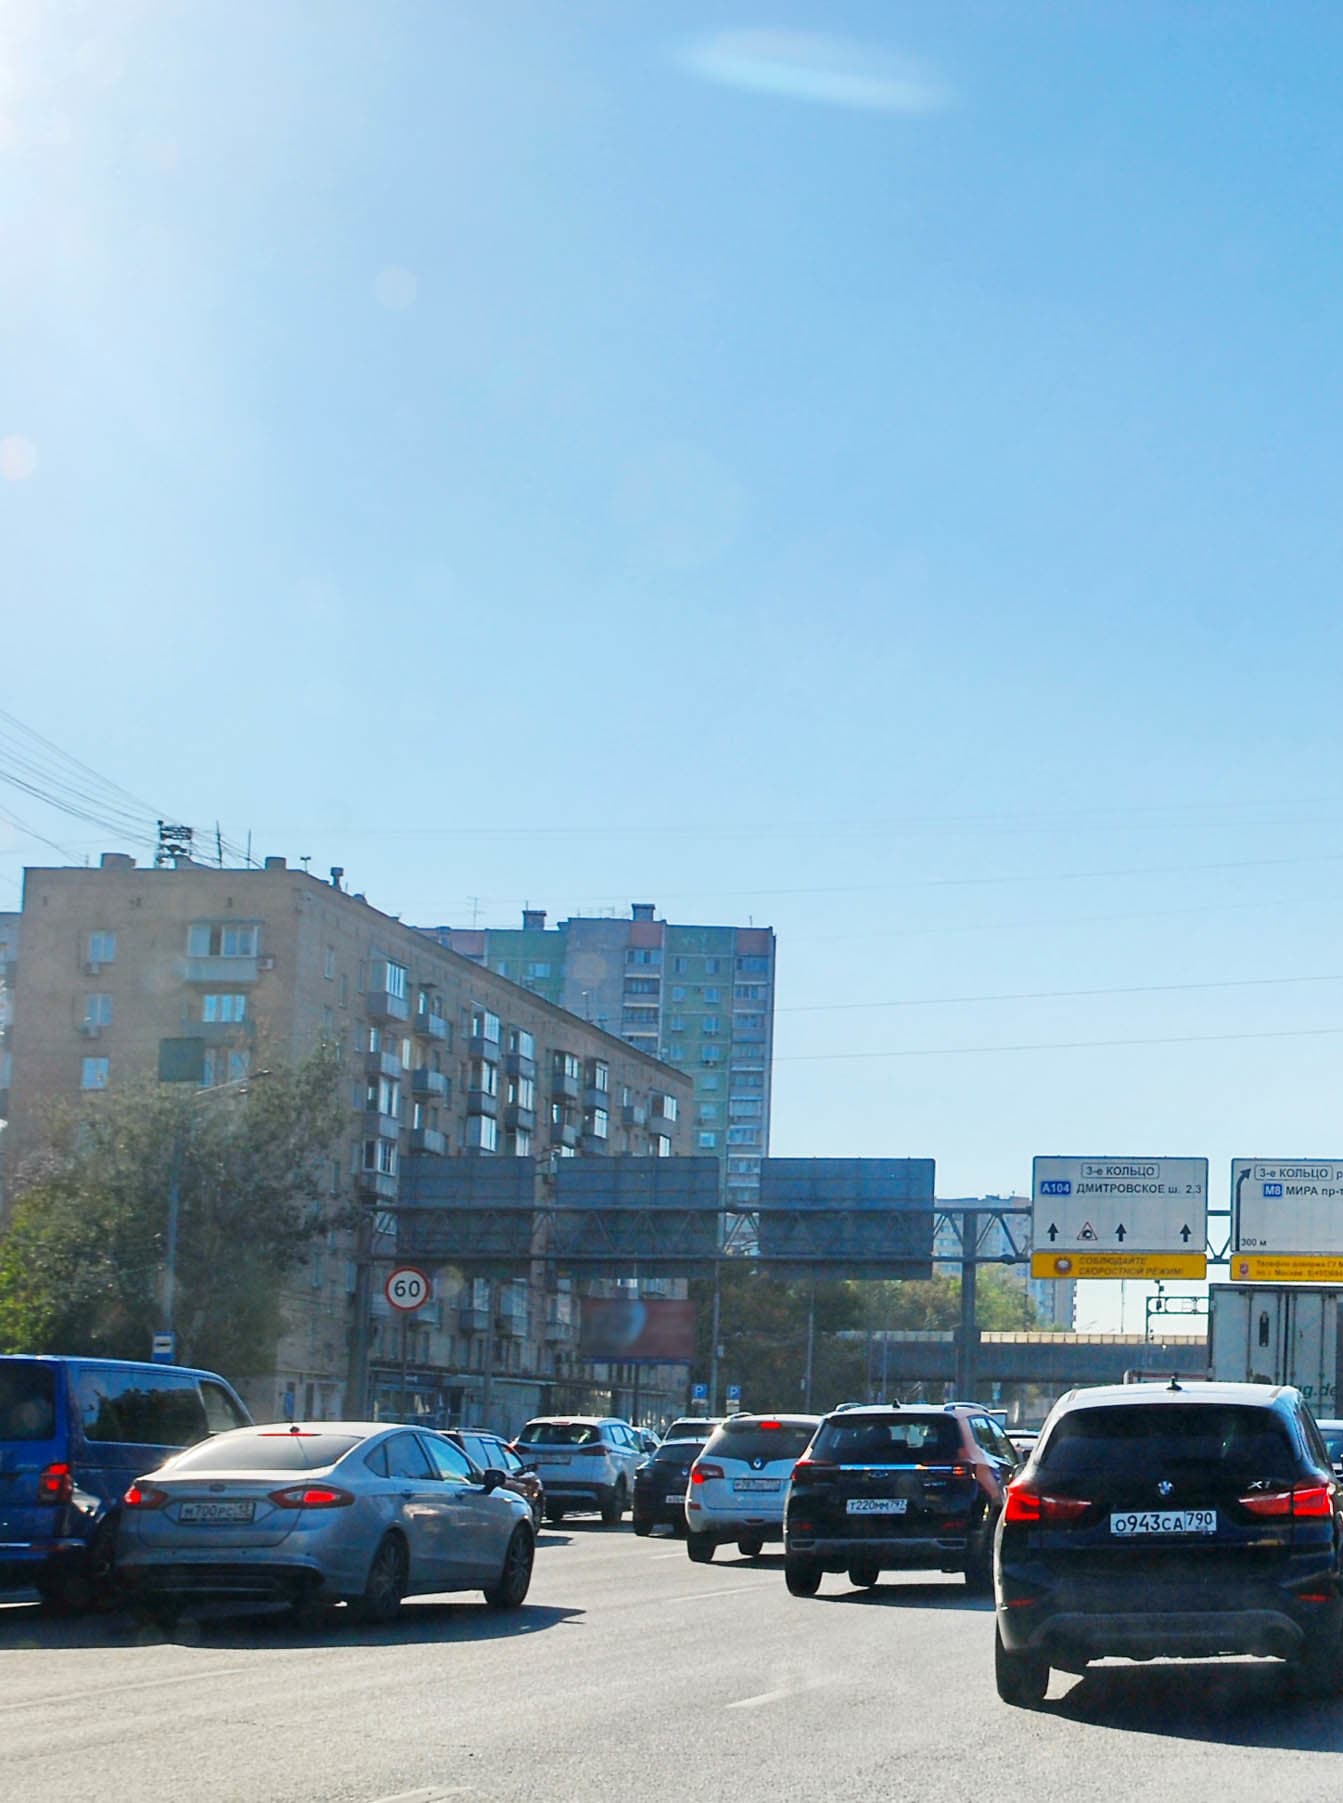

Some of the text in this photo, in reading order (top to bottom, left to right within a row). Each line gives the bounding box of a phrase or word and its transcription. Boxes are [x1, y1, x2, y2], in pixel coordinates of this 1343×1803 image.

[1106, 1166, 1155, 1177] КОЛЬЦО
[1259, 1169, 1276, 1178] 3-е
[1279, 1168, 1329, 1180] КОЛЬЦО
[1076, 1183, 1165, 1194] ДМИТРОВСКОЕ
[1286, 1186, 1318, 1196] МИРА
[394, 1280, 420, 1297] 60
